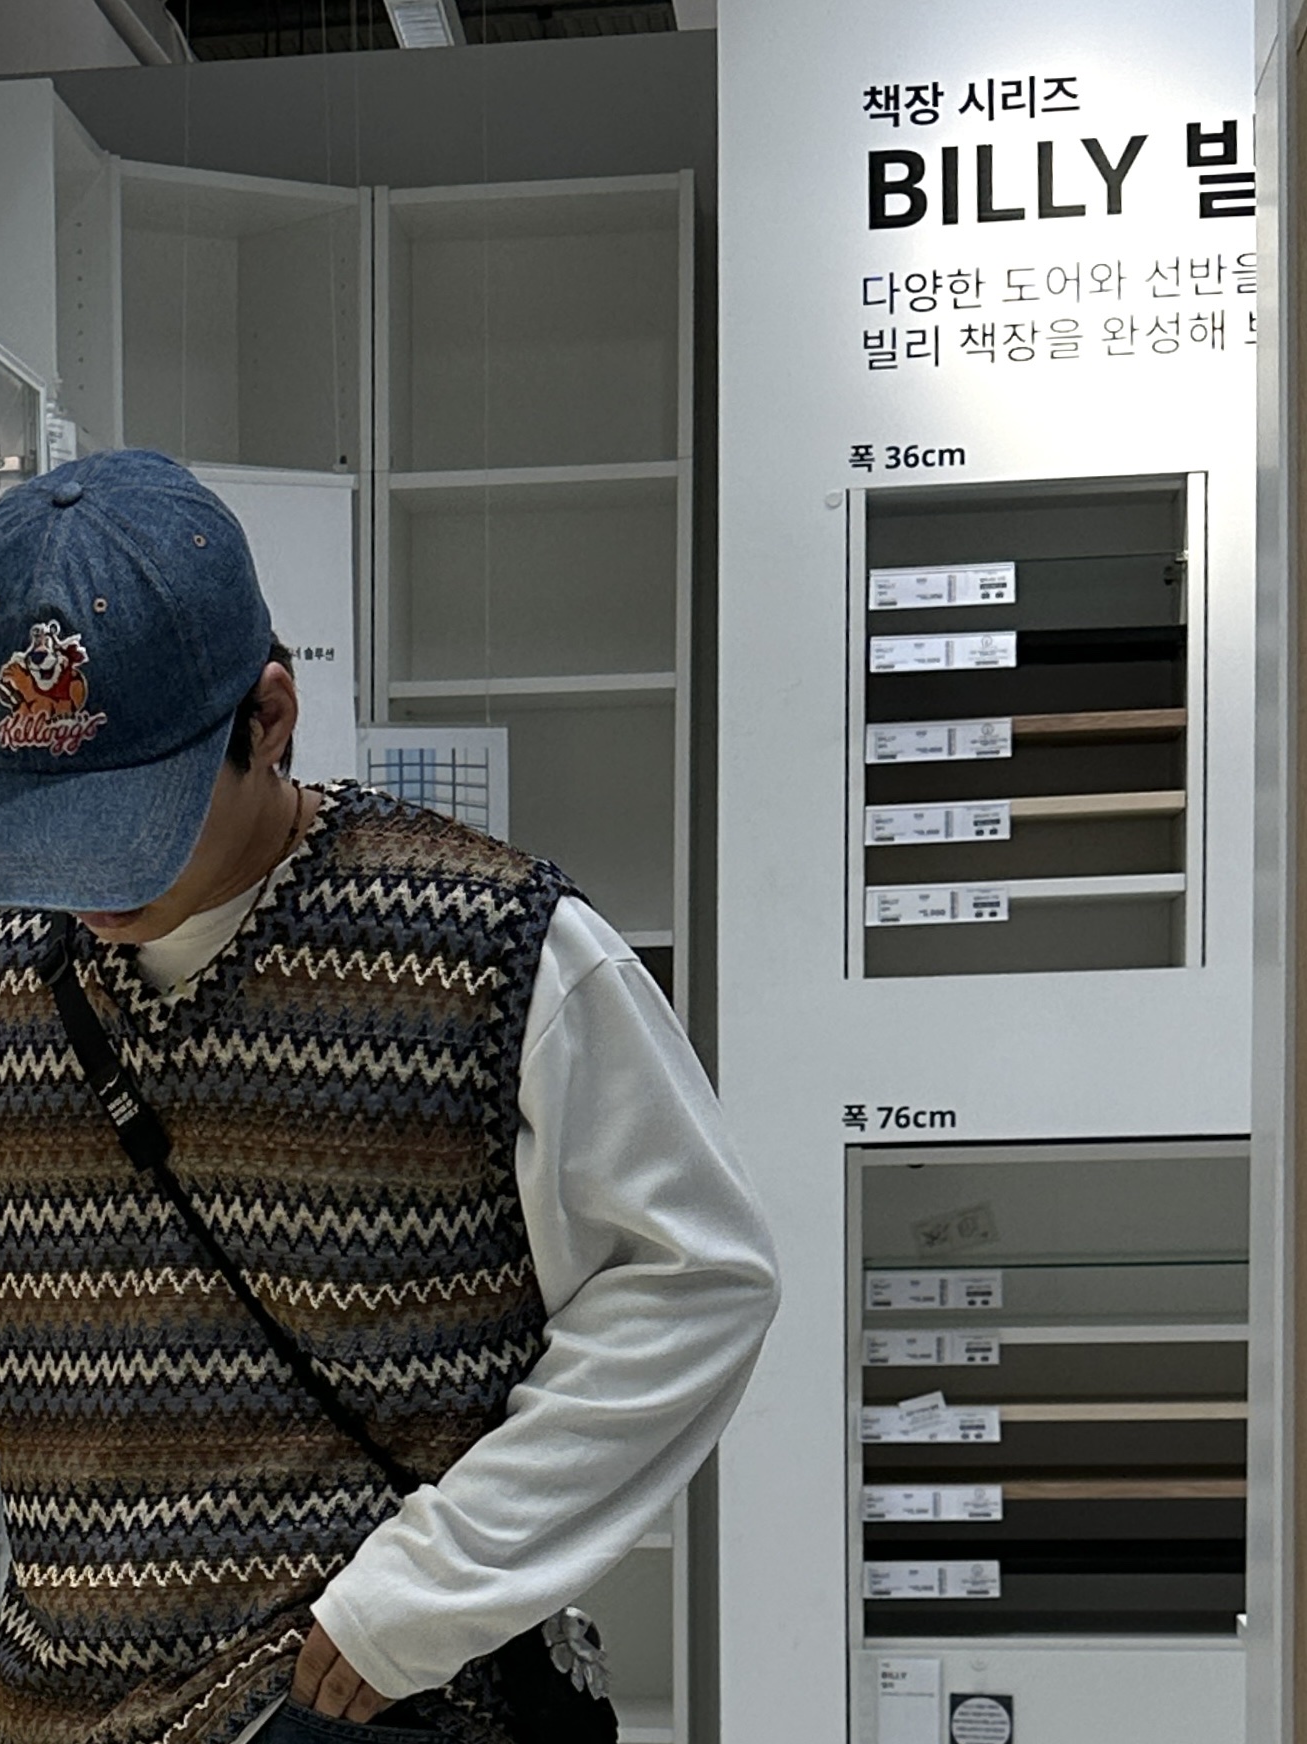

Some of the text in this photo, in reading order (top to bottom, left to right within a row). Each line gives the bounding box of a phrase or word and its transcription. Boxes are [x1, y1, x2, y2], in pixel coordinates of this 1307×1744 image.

[862, 76, 1081, 128] 책장 시리즈
[868, 135, 1149, 231] BILLY
[862, 268, 987, 315] 다양한
[1001, 260, 1127, 303] 도어와
[862, 326, 941, 371] 빌리
[960, 318, 1084, 364] 책장을
[1102, 310, 1225, 357] 완성해
[848, 444, 967, 474] 폭 36cm
[842, 1104, 957, 1132] 폭 76cm
